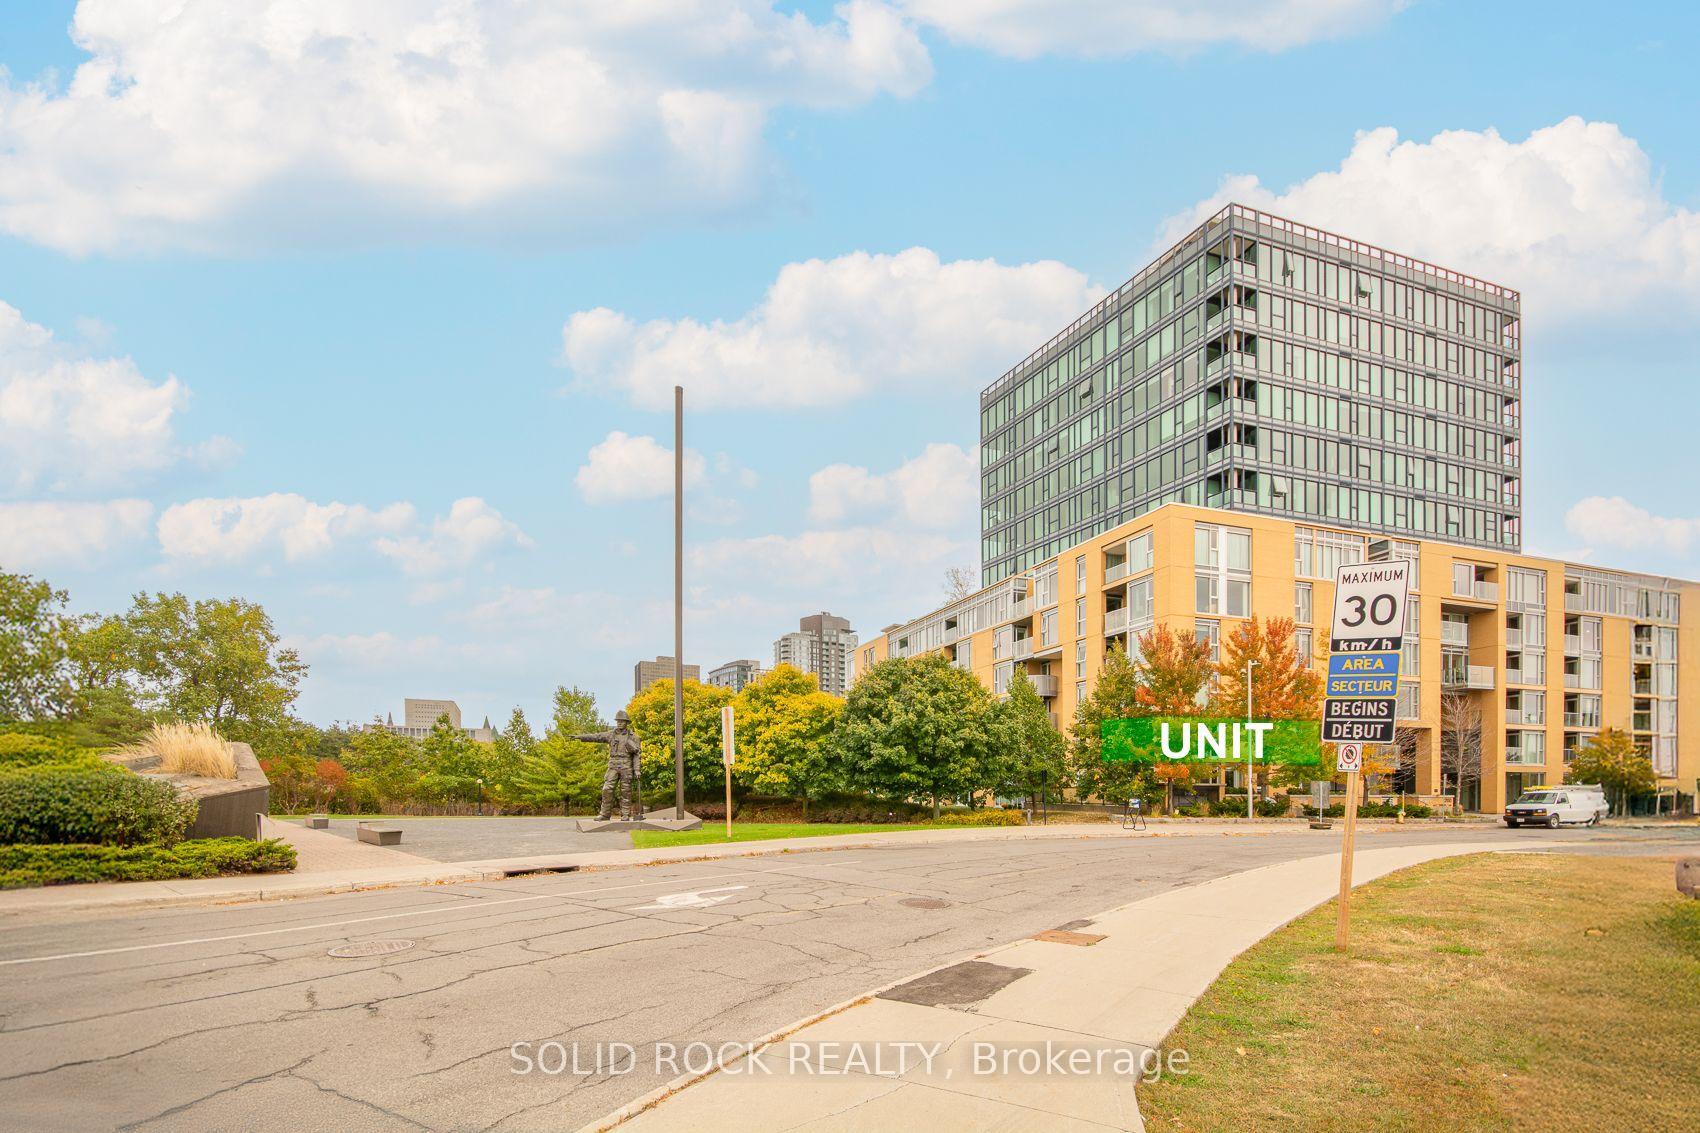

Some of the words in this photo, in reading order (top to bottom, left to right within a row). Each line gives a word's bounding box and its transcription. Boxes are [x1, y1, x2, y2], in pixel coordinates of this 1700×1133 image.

[1342, 569, 1403, 585] MAXIMUM
[1341, 593, 1397, 627] 30
[1339, 638, 1392, 651] km/h
[1341, 658, 1384, 671] AREA
[1331, 680, 1392, 693] SECTEUR
[1331, 701, 1389, 716] BEGINS
[1331, 720, 1384, 739] DÉBUT
